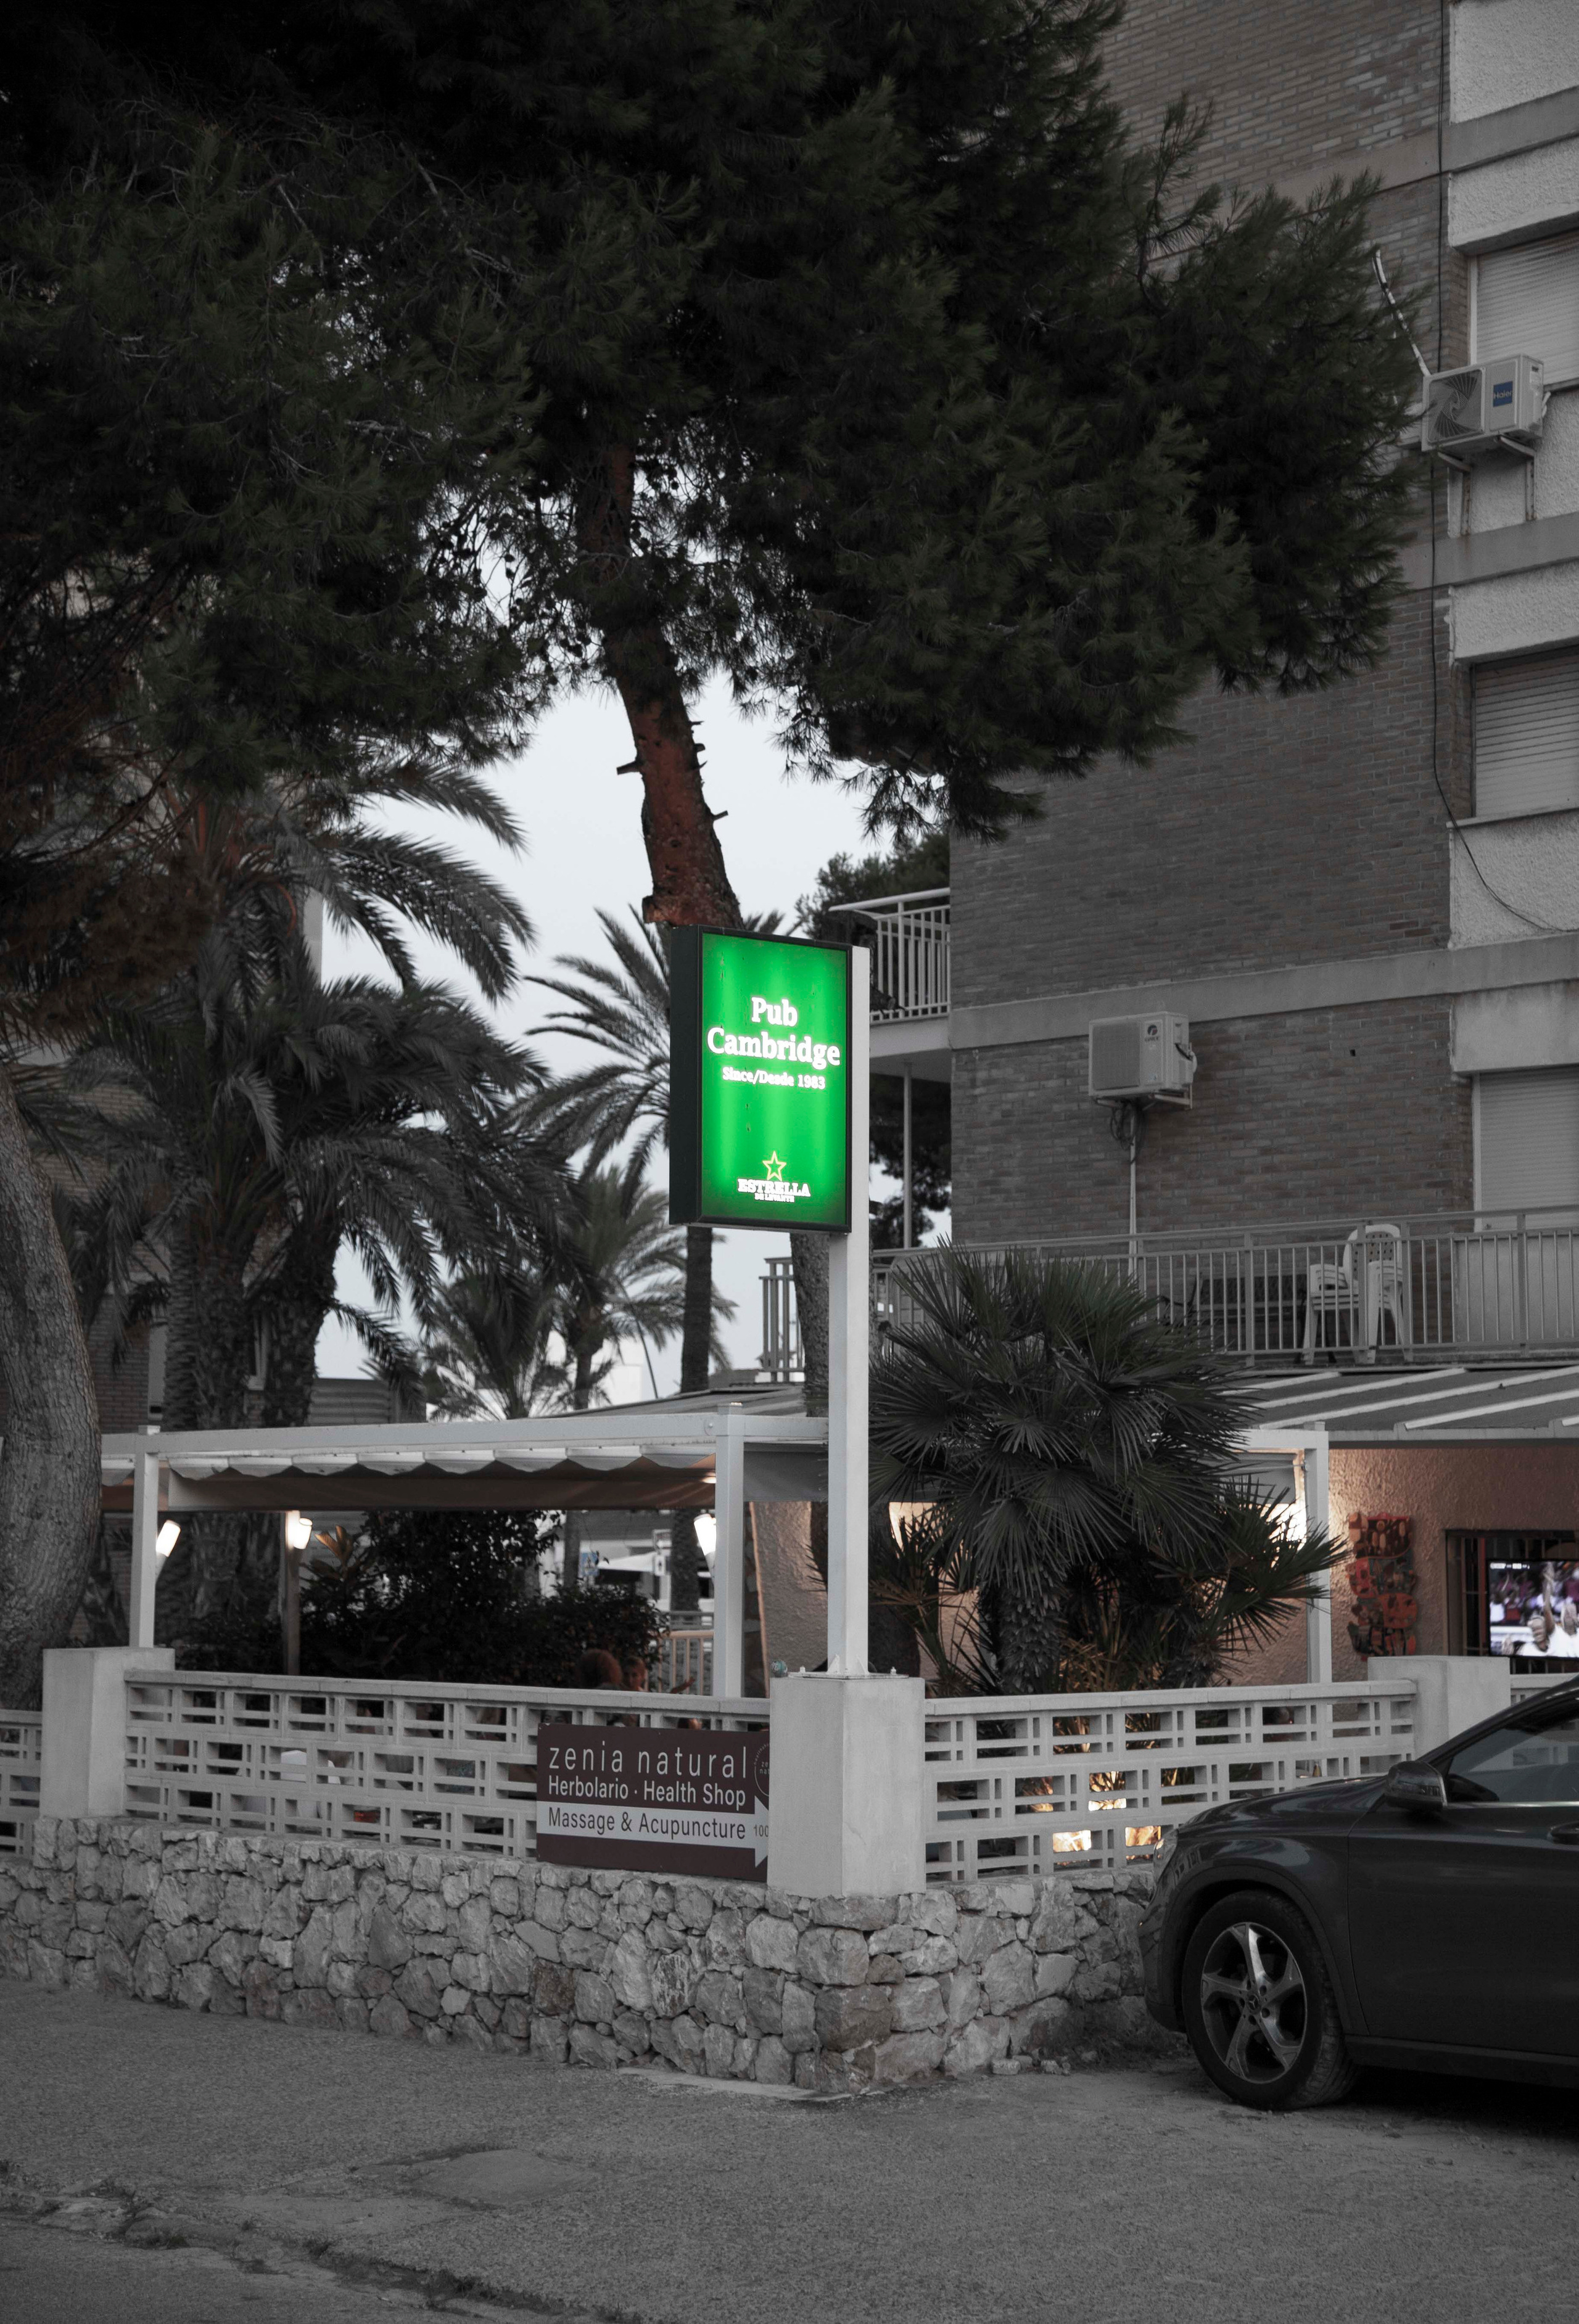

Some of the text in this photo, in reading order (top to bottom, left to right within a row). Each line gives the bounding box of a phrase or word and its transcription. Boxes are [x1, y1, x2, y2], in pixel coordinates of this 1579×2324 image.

[1493, 390, 1512, 400] Haier
[751, 996, 798, 1027] Pub
[707, 1027, 841, 1070] Cambridge
[722, 1066, 826, 1090] Since/Desde 1983
[738, 1178, 811, 1197] ESTRELLA
[549, 1740, 746, 1778] zenia natural
[548, 1775, 629, 1799] Herbolario
[643, 1780, 696, 1804] Health
[703, 1783, 746, 1811] Shop
[548, 1807, 615, 1835] Massage
[621, 1812, 632, 1832] &
[638, 1813, 746, 1839] Acupuncture
